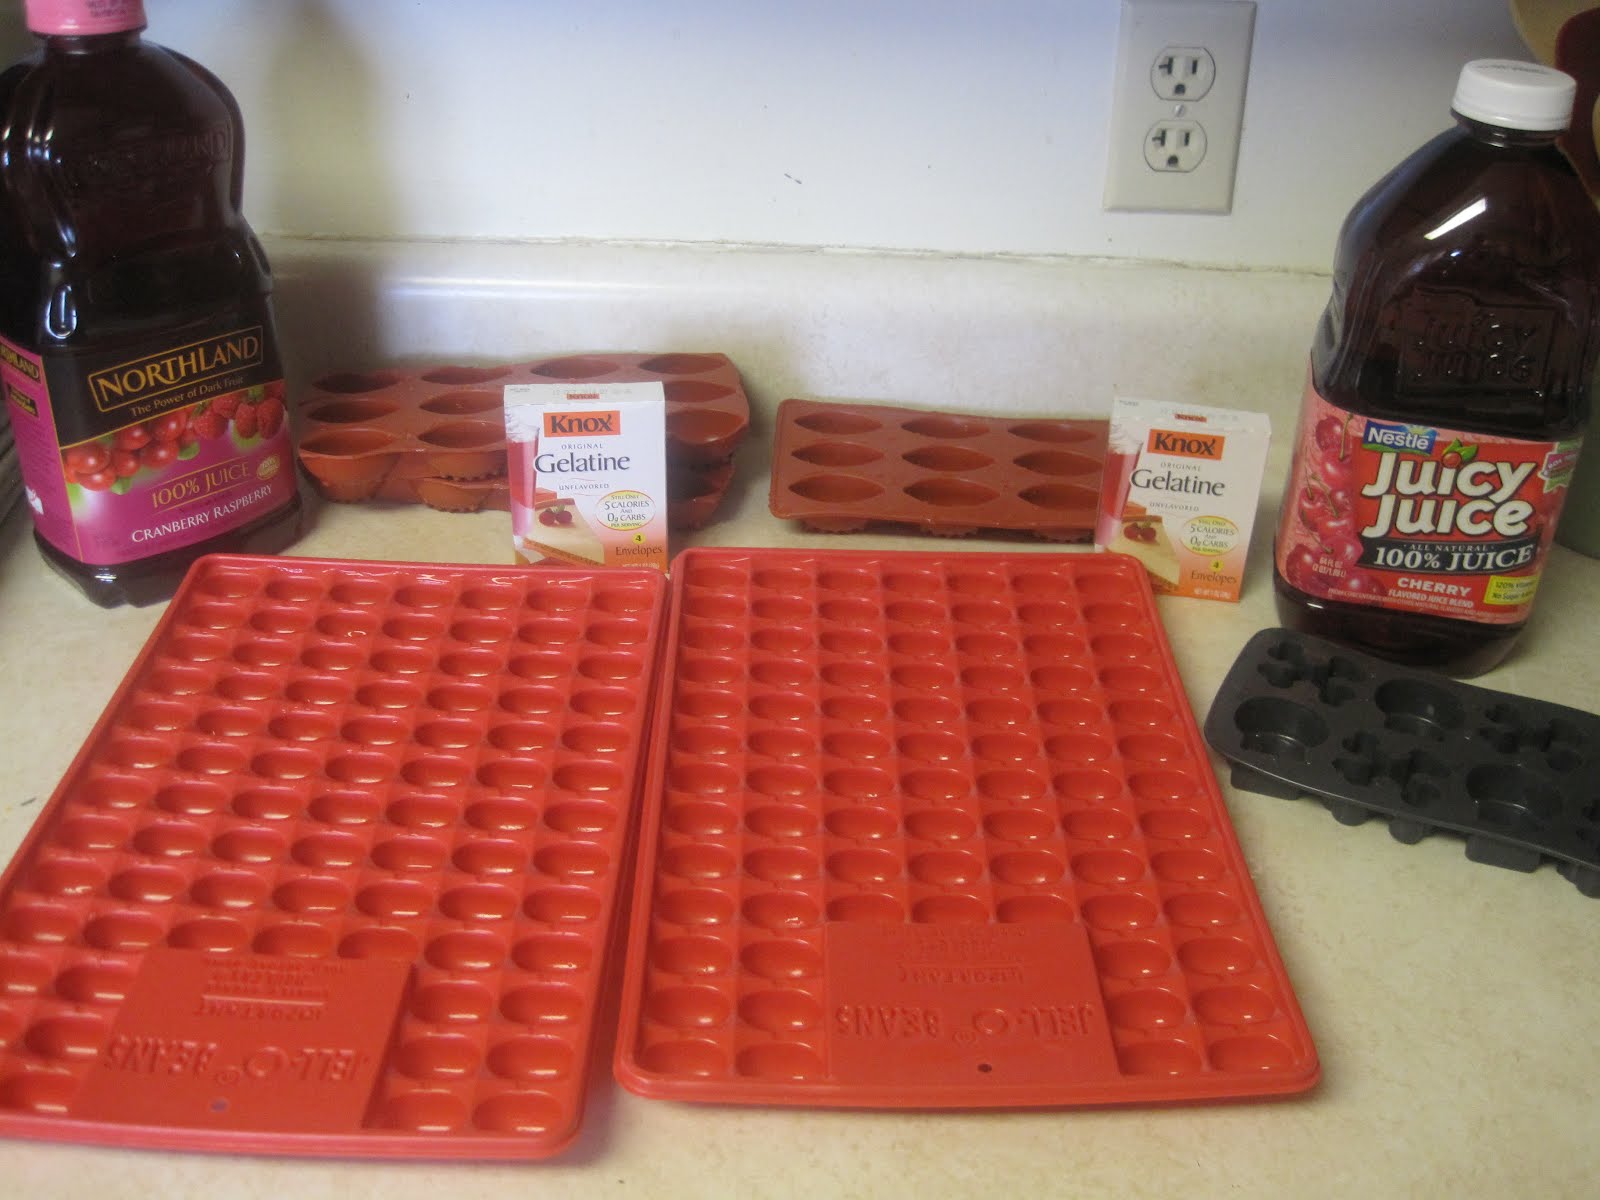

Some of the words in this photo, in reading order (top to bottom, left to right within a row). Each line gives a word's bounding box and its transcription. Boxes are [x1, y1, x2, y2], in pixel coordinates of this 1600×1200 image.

[97, 336, 258, 401] NORTHLAND
[131, 402, 152, 417] The
[154, 392, 184, 409] Power
[187, 386, 198, 399] of
[200, 381, 222, 395] Dark
[224, 376, 244, 389] Fruit
[551, 414, 613, 433] Knox
[1154, 433, 1216, 456] Knox
[1368, 426, 1430, 450] Nestlé
[535, 452, 630, 473] Gelatine
[1160, 462, 1201, 472] ORIGINAL
[152, 478, 200, 509] 100%
[205, 461, 249, 493] JUICE
[1131, 469, 1225, 496] Gelatine
[1361, 452, 1536, 502] Juicy
[559, 483, 610, 491] UNFLAVORED
[131, 511, 210, 543] CRANBERRY
[213, 484, 272, 520] RASPBERRY
[604, 501, 610, 511] 5
[611, 500, 650, 509] CALORIES
[620, 513, 646, 522] CARBS
[1361, 494, 1533, 538] Juice
[1190, 523, 1196, 533] 5
[1197, 527, 1235, 536] CALORIES
[615, 545, 662, 557] Envelopes
[1202, 540, 1229, 548] CARBS
[1410, 543, 1430, 551] ALL
[1435, 544, 1489, 552] NATURAL
[1213, 561, 1219, 569] 4
[1374, 546, 1441, 569] 100%
[1446, 544, 1534, 571] JUICE
[1191, 570, 1237, 585] Envelopes
[1397, 577, 1473, 597] CHERRY
[1388, 589, 1427, 601] FLAVORED
[1429, 595, 1448, 605] JUICE
[1449, 598, 1474, 608] BLEND
